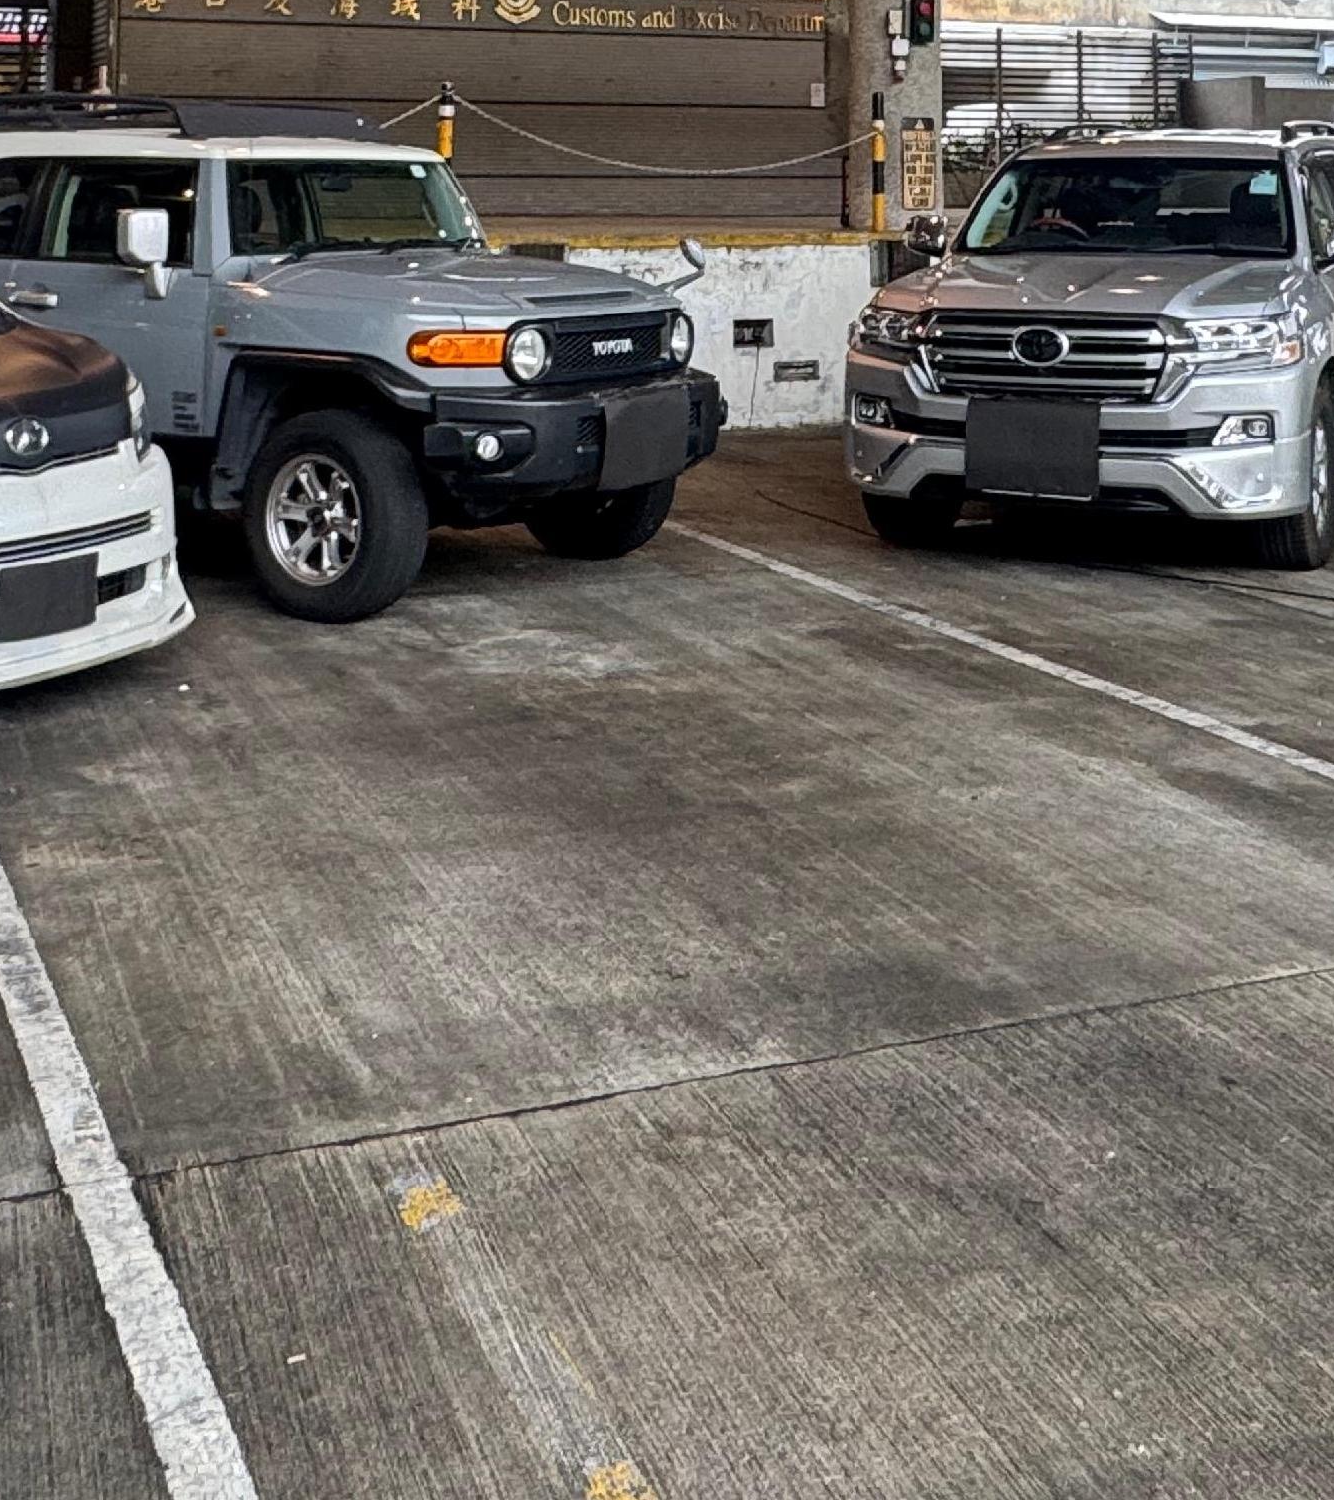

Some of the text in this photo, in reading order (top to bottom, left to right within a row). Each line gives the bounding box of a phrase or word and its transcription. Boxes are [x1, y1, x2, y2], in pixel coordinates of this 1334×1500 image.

[553, 0, 635, 28] Customs
[641, 5, 675, 28] and
[592, 338, 633, 357] TOYOTA
